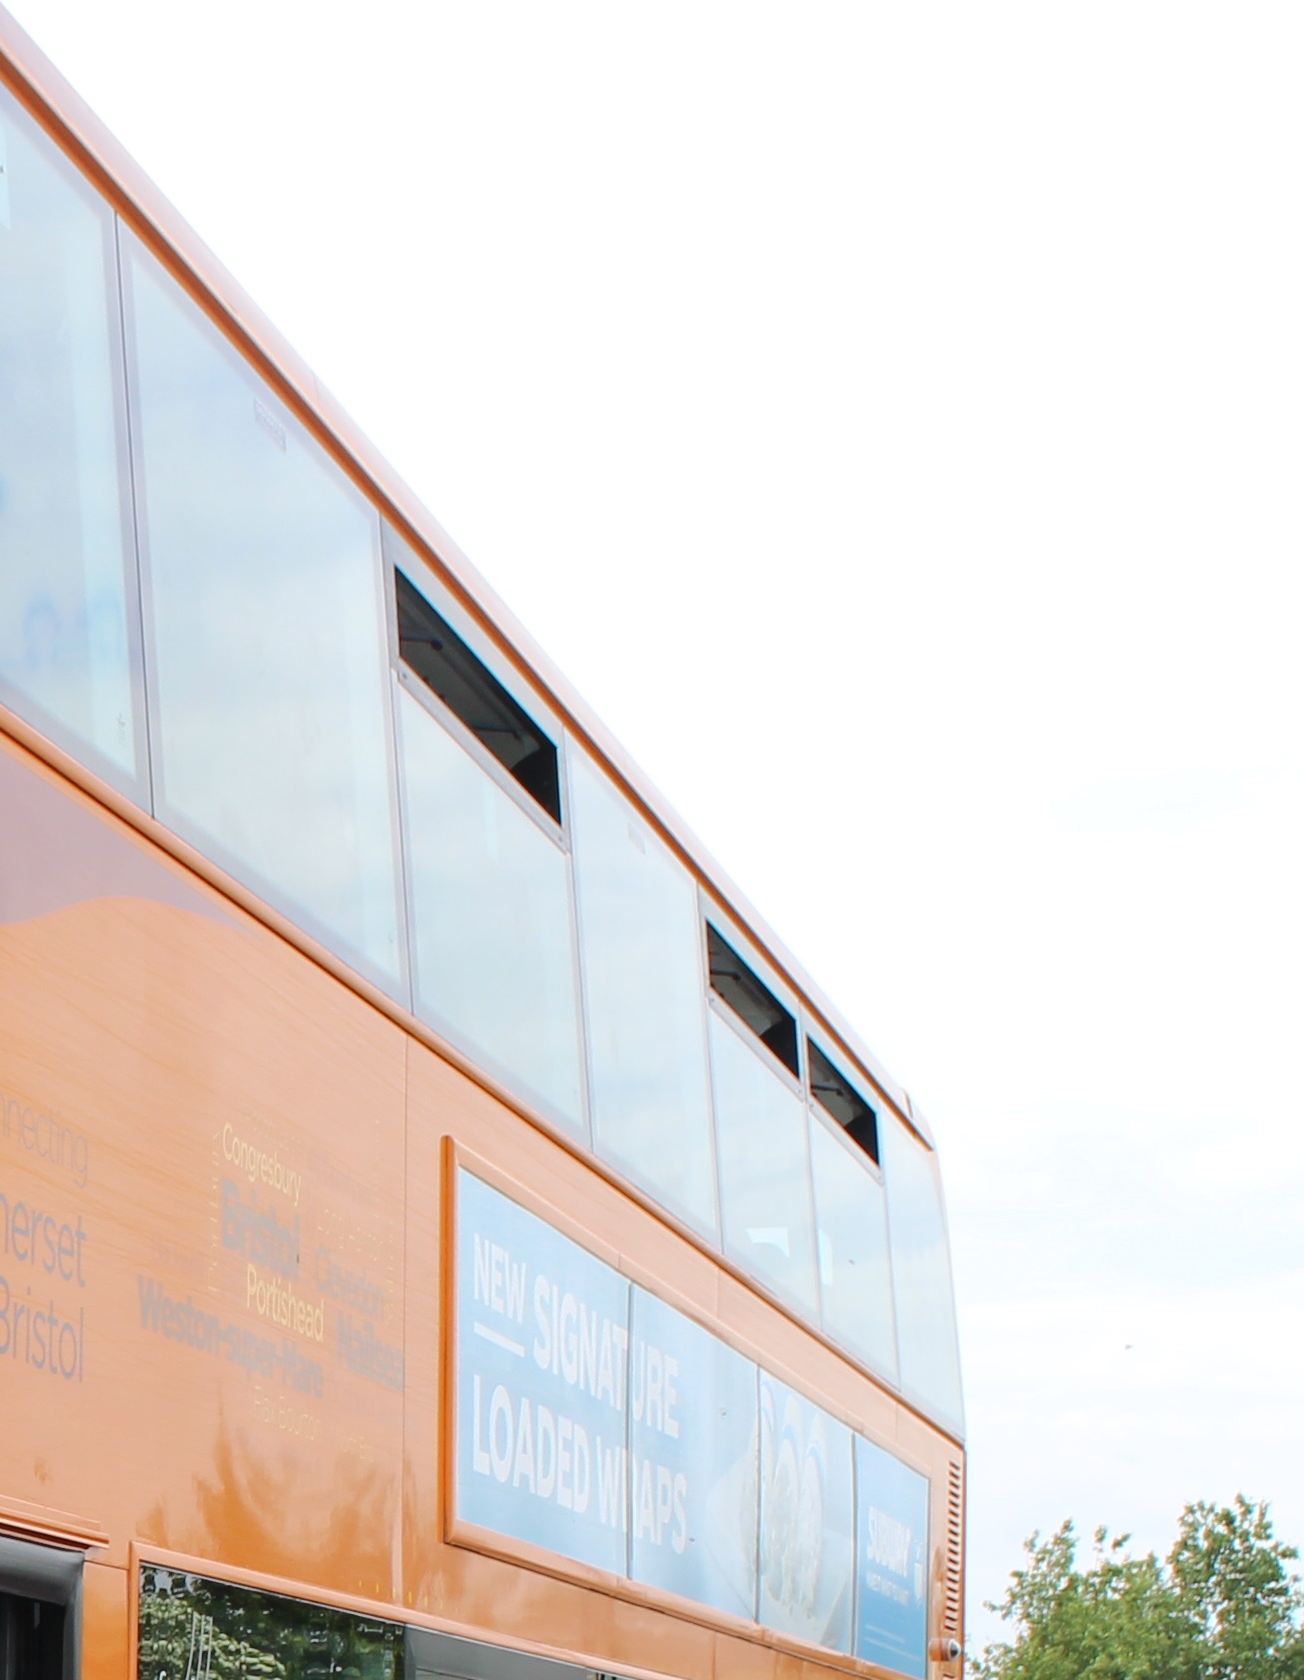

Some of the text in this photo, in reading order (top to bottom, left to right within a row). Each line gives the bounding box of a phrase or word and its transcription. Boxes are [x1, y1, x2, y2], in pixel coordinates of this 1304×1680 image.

[223, 1122, 302, 1207] Congresbury
[222, 1176, 301, 1284] Bristol
[246, 1262, 324, 1342] Portishead
[473, 1233, 527, 1324] NEW
[534, 1273, 679, 1439] SIGNATURE
[472, 1373, 590, 1514] LOADED
